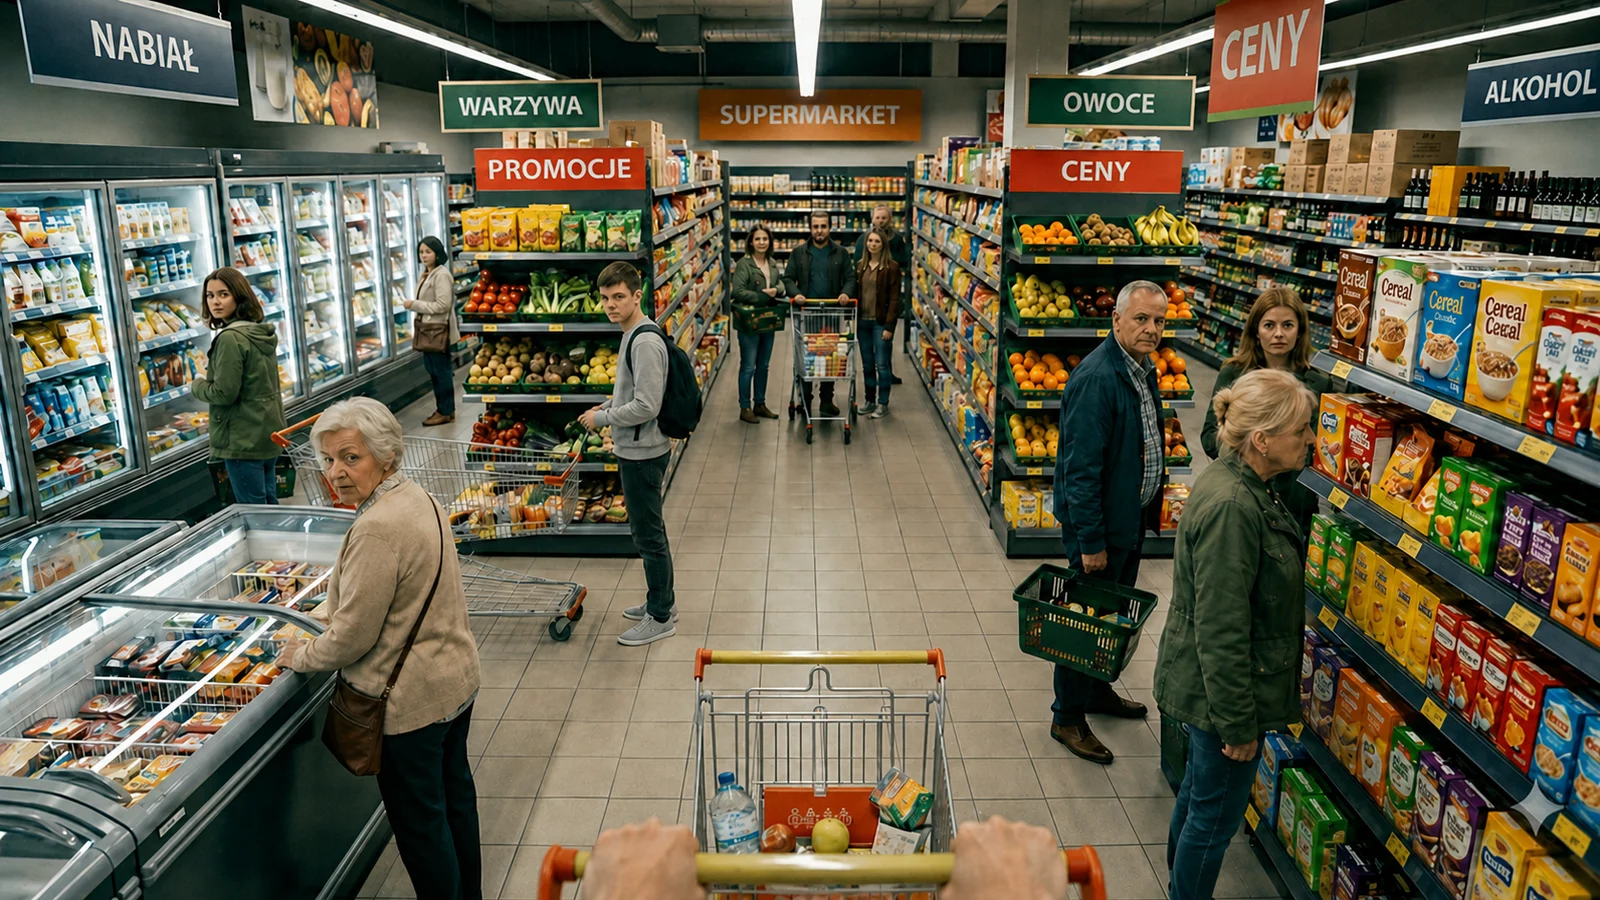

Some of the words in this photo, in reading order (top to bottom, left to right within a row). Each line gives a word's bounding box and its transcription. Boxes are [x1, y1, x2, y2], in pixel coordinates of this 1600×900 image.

[90, 19, 200, 74] NABIAŁ
[1221, 8, 1311, 80] CENY
[1484, 68, 1597, 105] ALKOHOL
[458, 95, 583, 117] WARZYWA
[1063, 91, 1155, 114] OWOCE
[719, 104, 900, 125] SUPERMARKET
[488, 158, 632, 180] PROMOCJE
[1061, 160, 1132, 182] CENY
[1340, 266, 1369, 289] Cereal
[1381, 278, 1413, 301] Cereal
[1429, 290, 1464, 315] Cereal
[1485, 296, 1528, 322] Cereal
